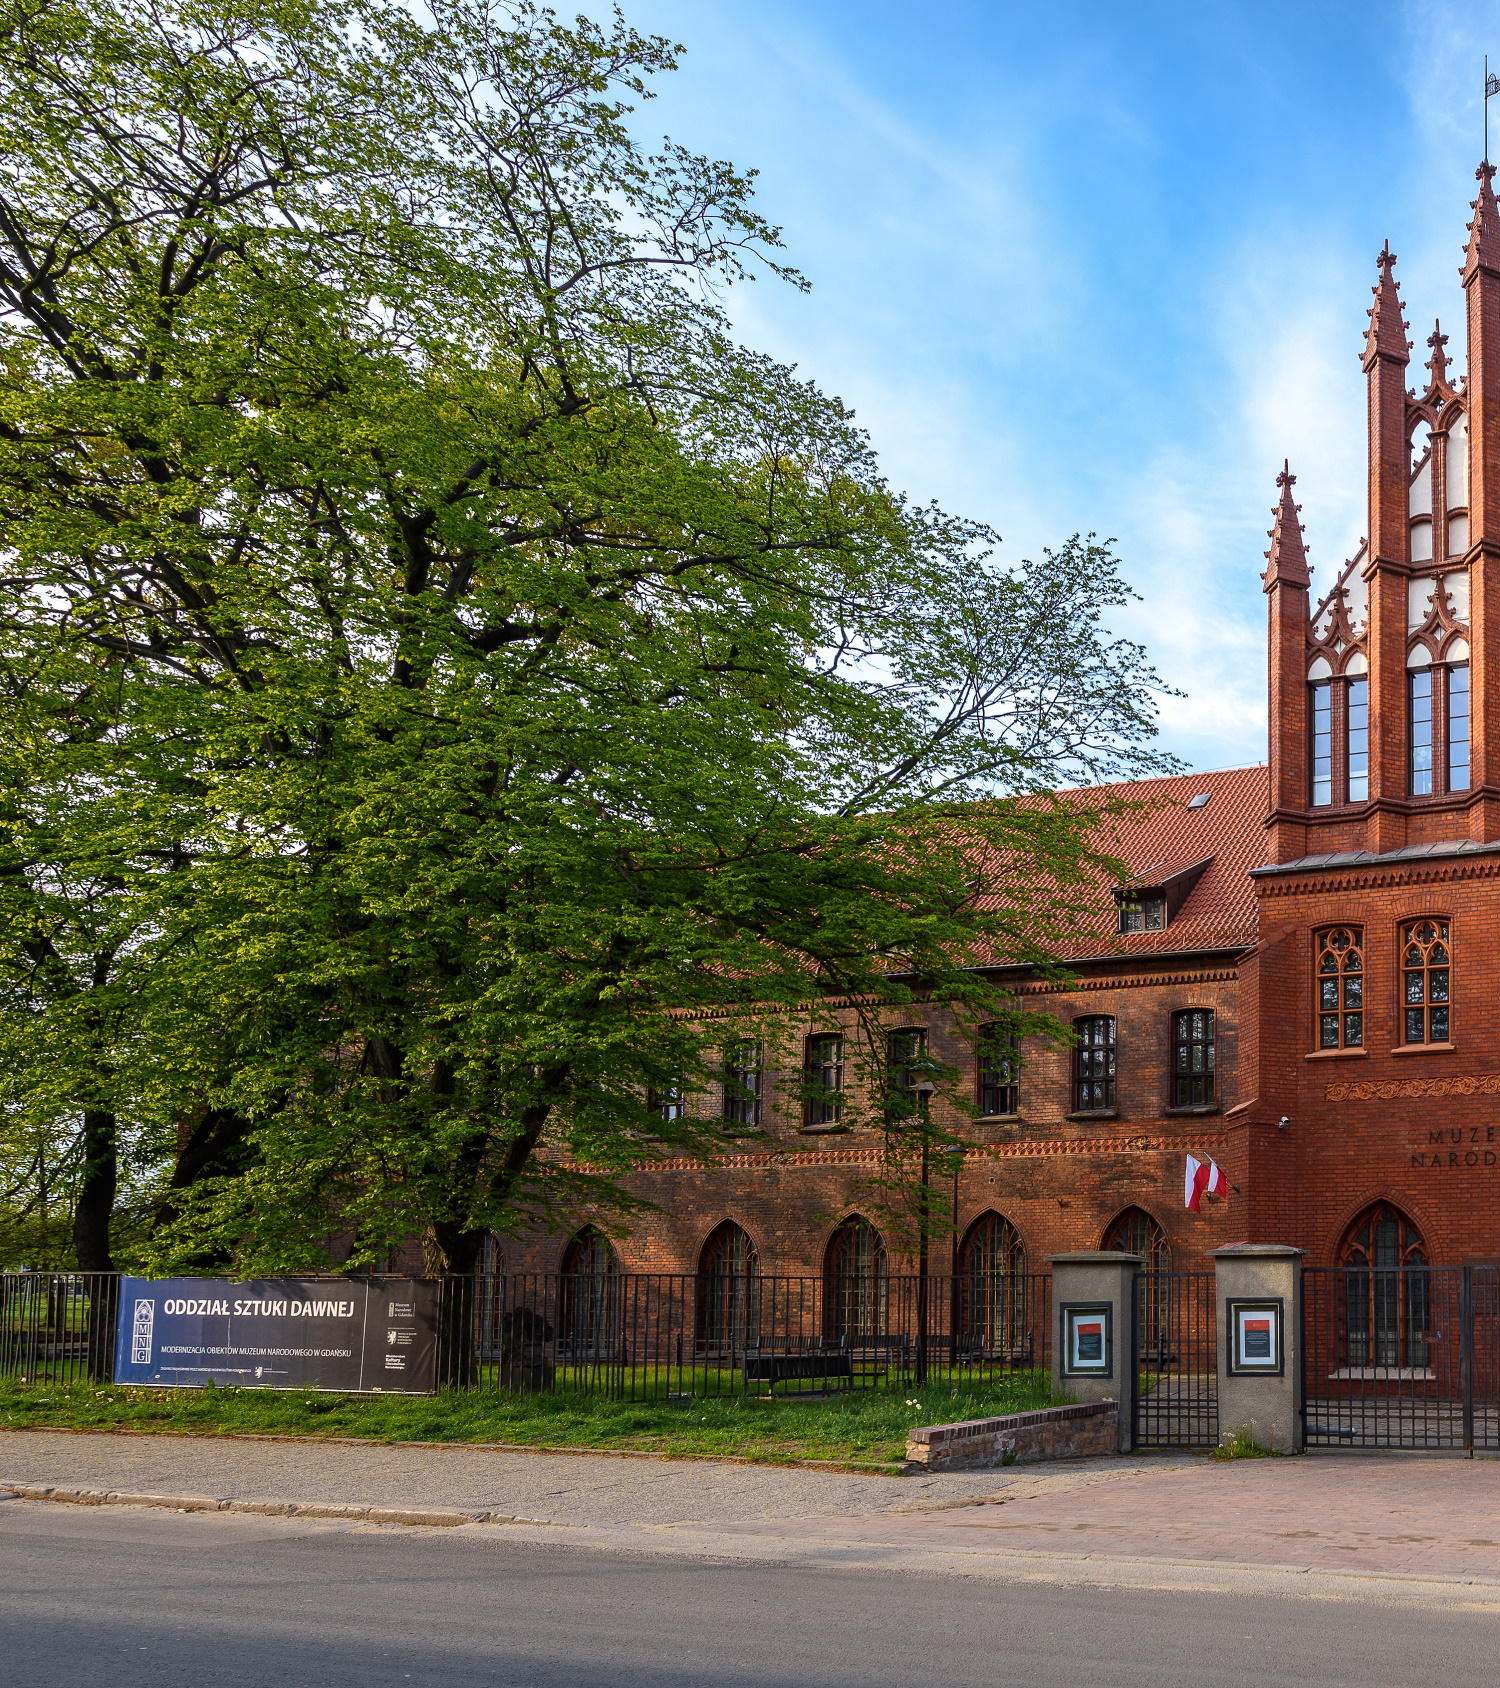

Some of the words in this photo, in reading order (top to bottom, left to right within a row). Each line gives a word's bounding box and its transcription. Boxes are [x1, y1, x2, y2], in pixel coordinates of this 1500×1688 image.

[164, 1299, 231, 1315] ODDZIAŁ
[233, 1300, 287, 1316] SZTUKI
[290, 1301, 355, 1317] DAWNEJ
[161, 1346, 206, 1354] MODERNIZACJA
[206, 1346, 239, 1355] OBIEKTÓW
[267, 1348, 314, 1356] NARODOWEGO
[321, 1348, 352, 1357] GDAŃSKU
